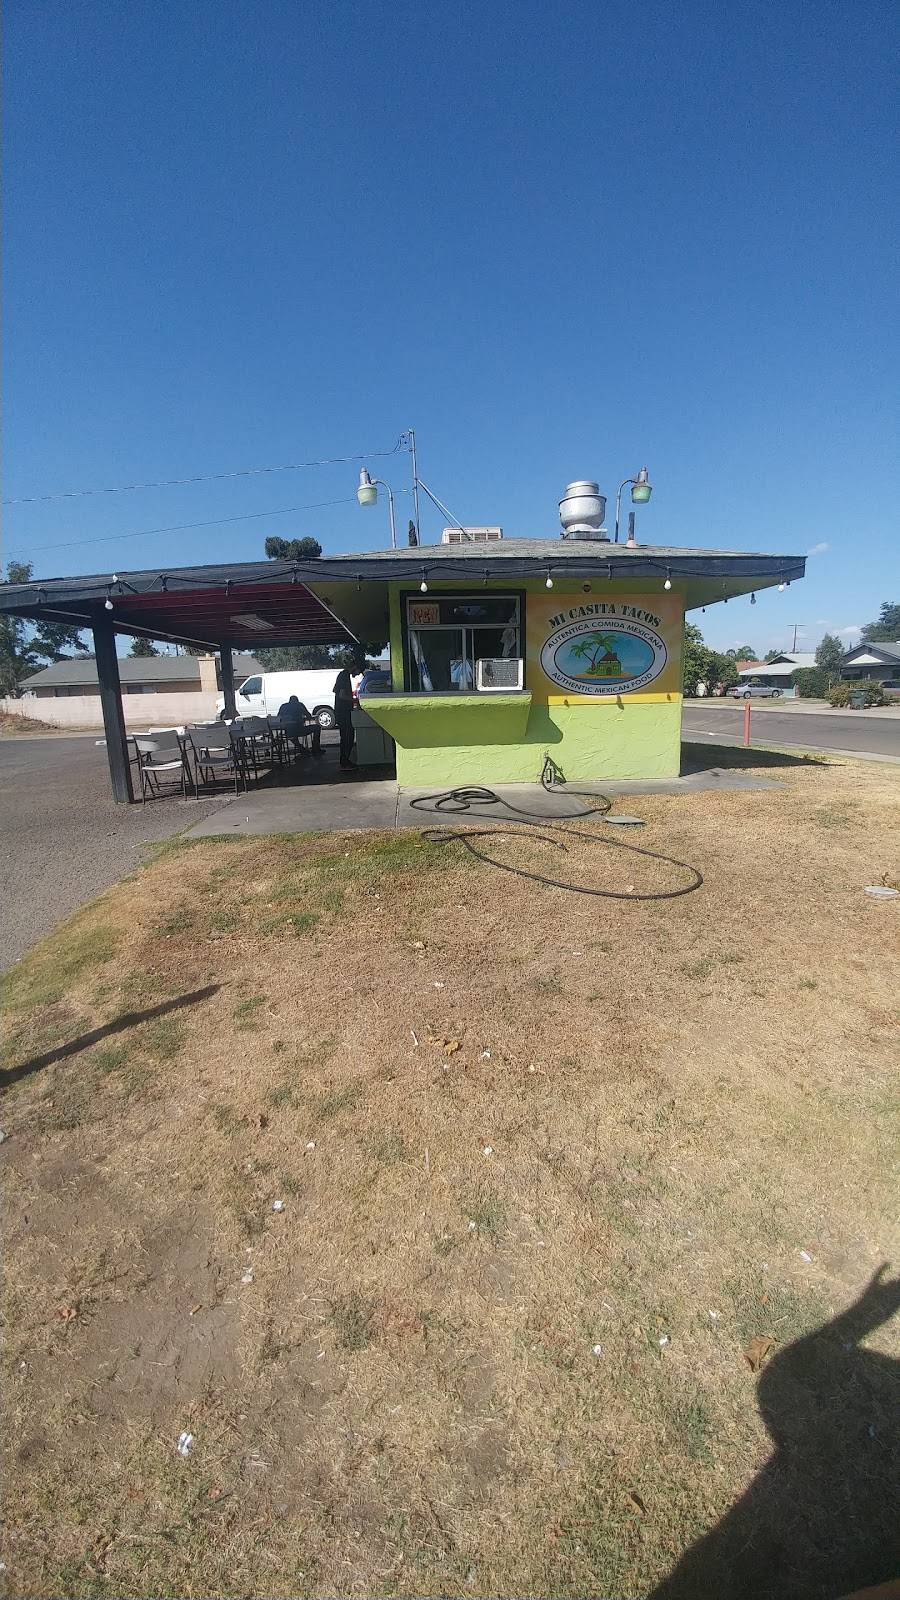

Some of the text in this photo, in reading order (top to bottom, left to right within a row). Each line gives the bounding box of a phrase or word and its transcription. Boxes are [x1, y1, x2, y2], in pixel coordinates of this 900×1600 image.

[548, 603, 663, 629] MI CASITA TACOS
[547, 621, 663, 650] AUTENTICA COMIDA MEXICANA
[552, 672, 653, 694] AUTHENTIC MEXICAN FOOD
